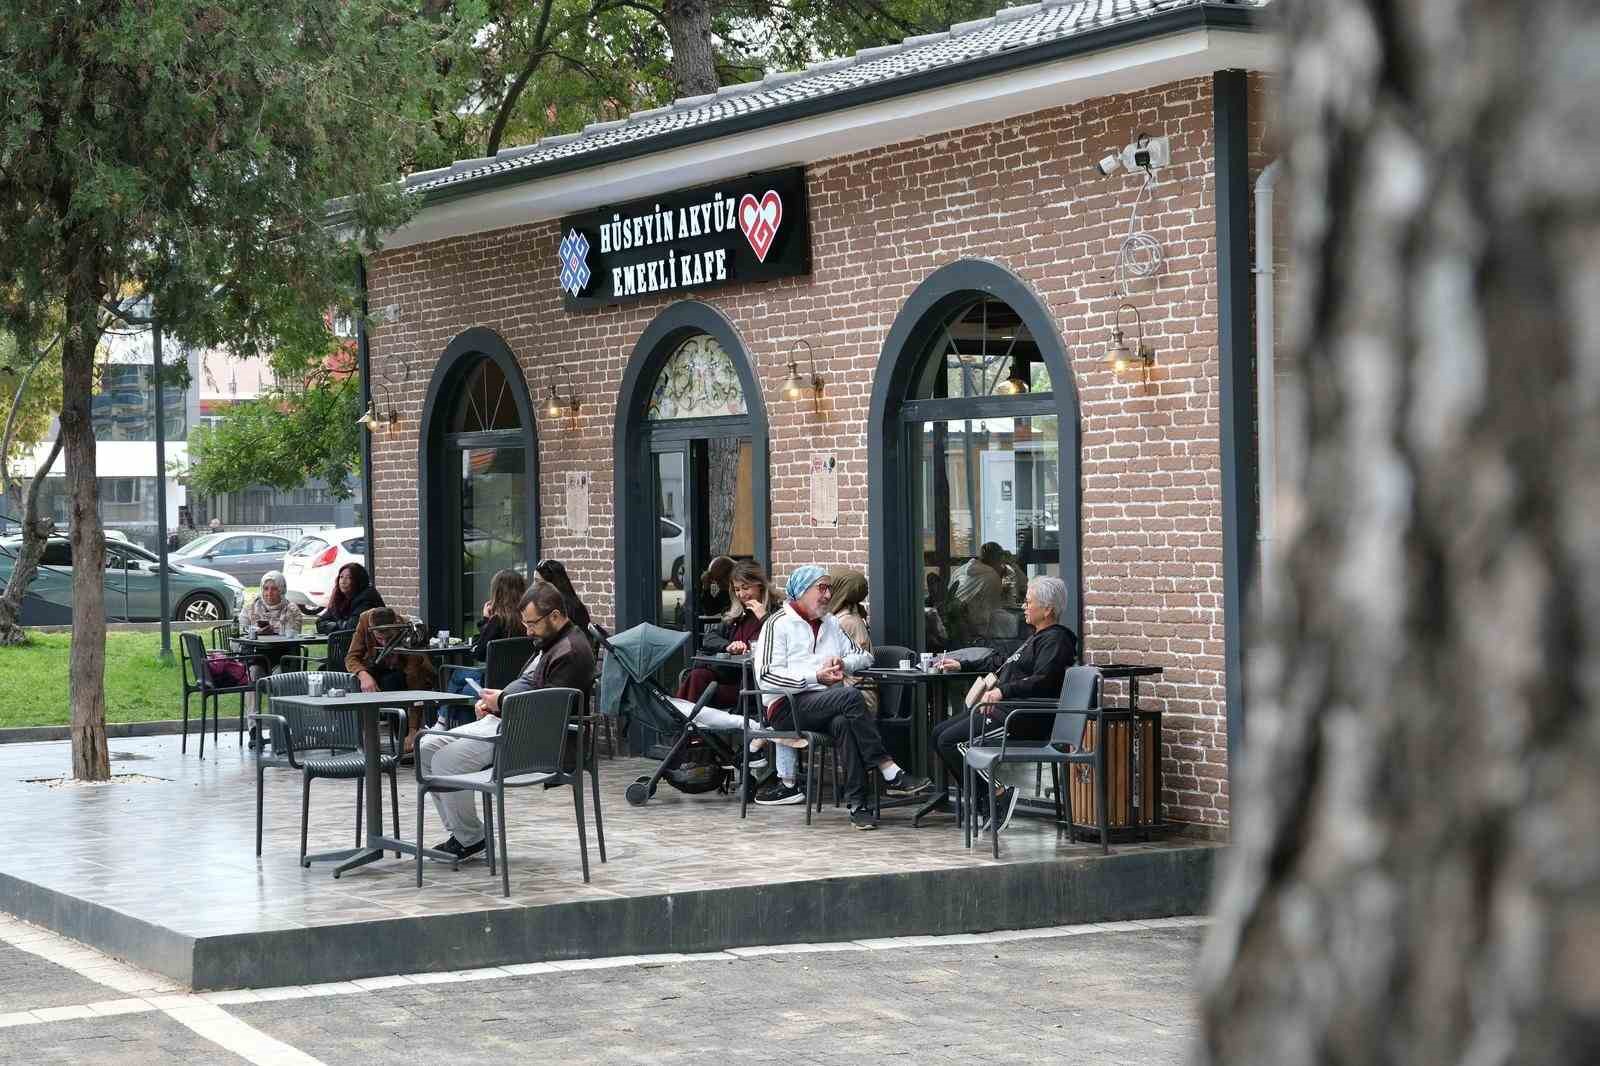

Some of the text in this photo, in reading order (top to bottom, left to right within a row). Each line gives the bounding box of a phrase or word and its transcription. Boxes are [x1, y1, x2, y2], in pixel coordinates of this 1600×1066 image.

[600, 192, 737, 254] HÜSEYİN AKYÜZ
[612, 248, 728, 297] EMEKLİ KAFE
